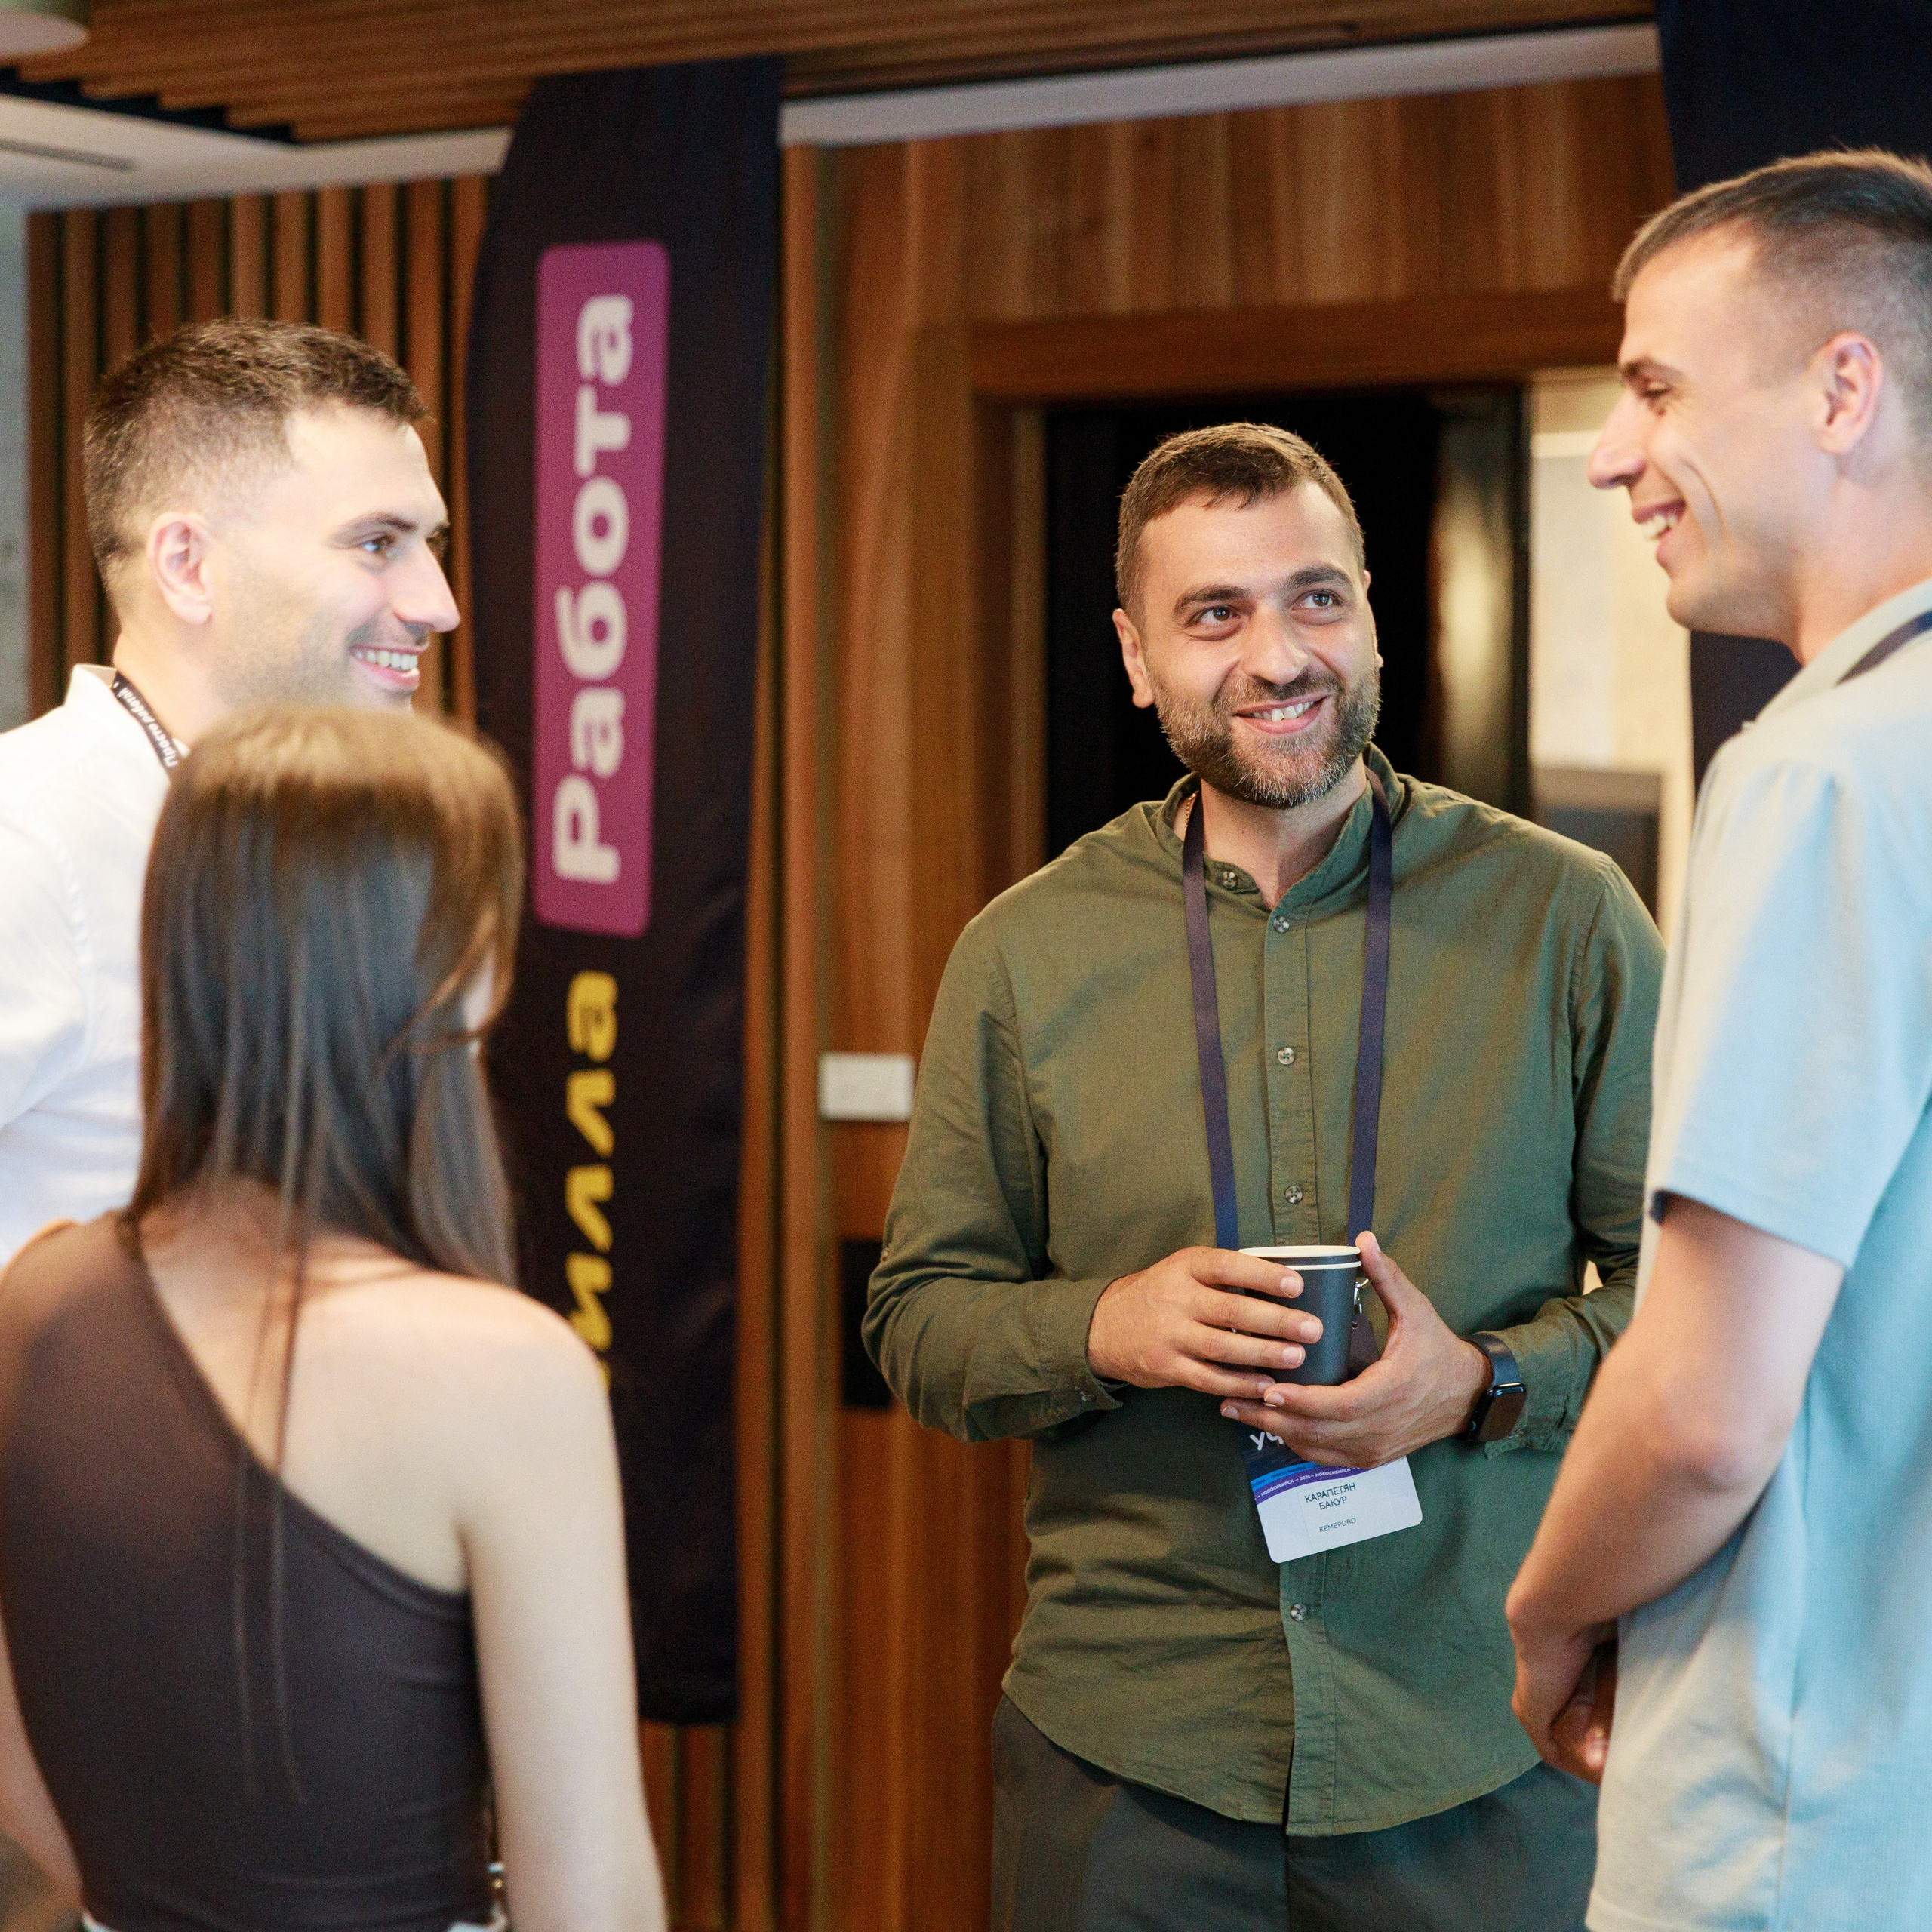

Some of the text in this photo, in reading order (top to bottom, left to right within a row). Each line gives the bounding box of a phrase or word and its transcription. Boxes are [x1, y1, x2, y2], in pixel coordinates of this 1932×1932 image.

[147, 722, 178, 768] Просто
[552, 293, 635, 1393] илла Работа
[1249, 1431, 1284, 1451] УЧ
[1260, 1478, 1294, 1497] НОВОСИБИРСК
[1315, 1468, 1351, 1477] НОВОСИБИРСК
[1304, 1482, 1356, 1503] КАРАПЕТЯН
[1318, 1496, 1347, 1510] БАКУР
[1318, 1517, 1356, 1533] КЕМЕРОВО
